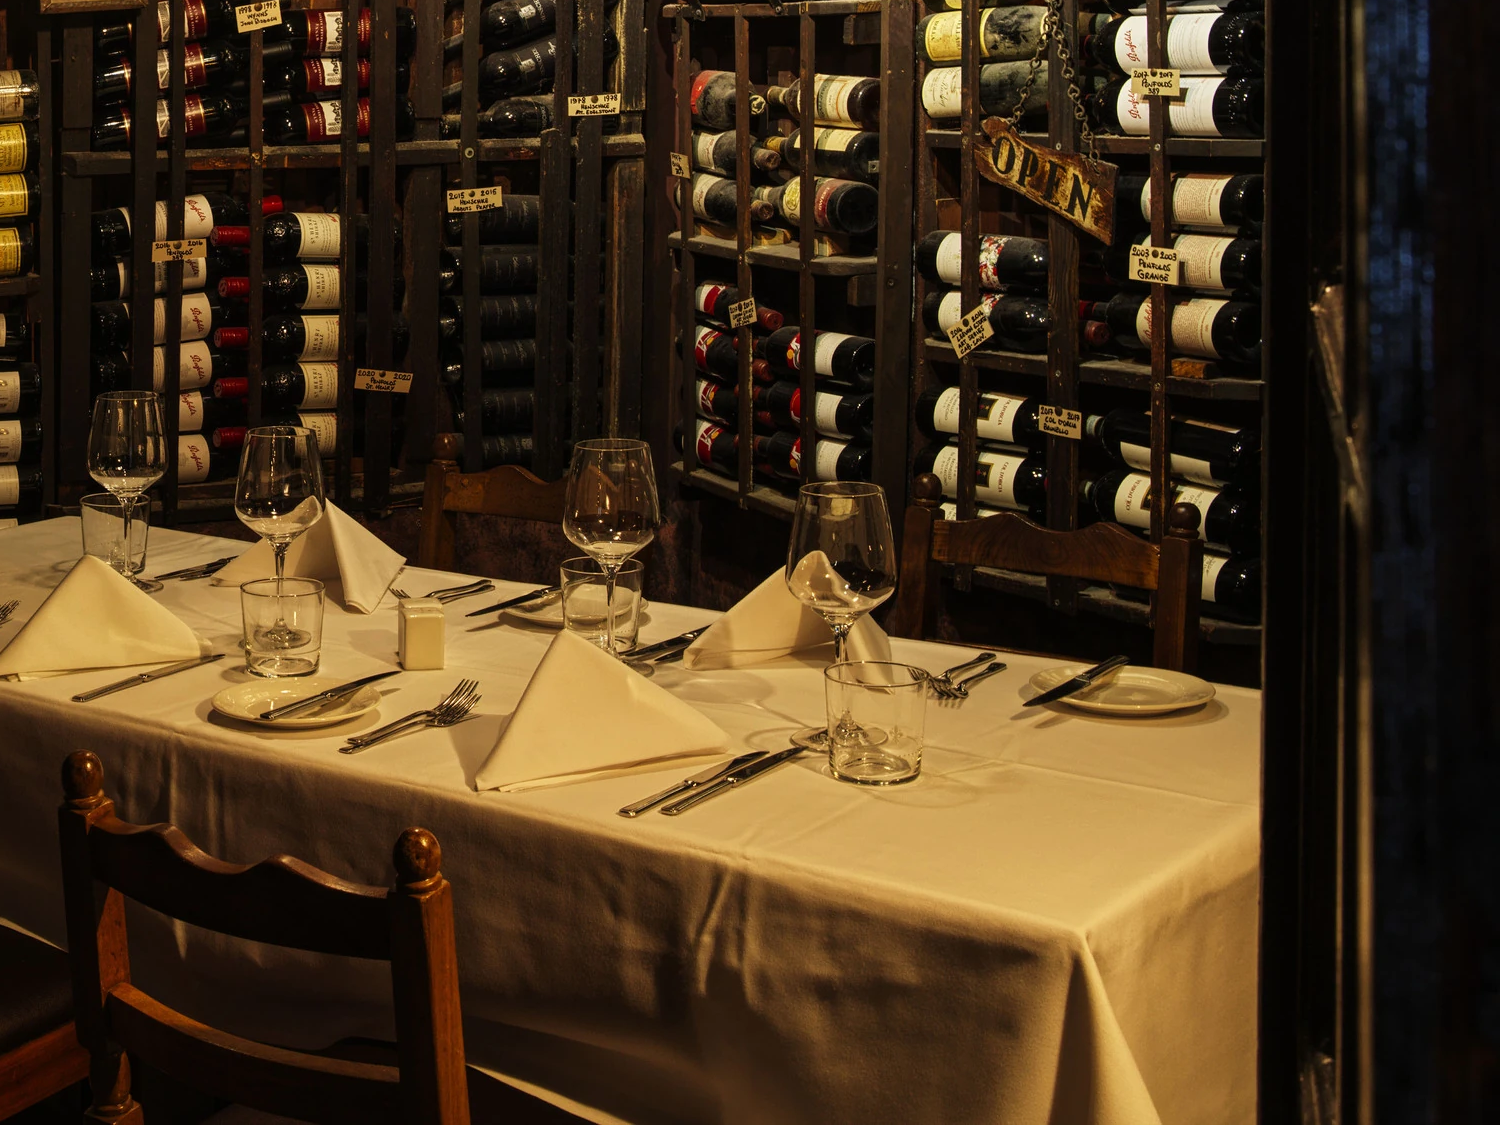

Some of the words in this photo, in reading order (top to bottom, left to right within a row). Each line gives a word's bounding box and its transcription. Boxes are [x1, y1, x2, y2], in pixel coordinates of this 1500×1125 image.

[1133, 70, 1149, 78] 2017
[1141, 78, 1173, 88] PENFOLDS
[991, 136, 1096, 223] OPEN
[449, 192, 465, 200] 2015
[1132, 247, 1149, 257] 2003
[1160, 251, 1177, 261] 2003
[1138, 258, 1171, 272] PENFOLDS
[1137, 269, 1169, 282] GRANGE
[358, 369, 375, 377] 2020
[393, 373, 411, 381] 2020
[370, 377, 396, 386] PENFOLDS
